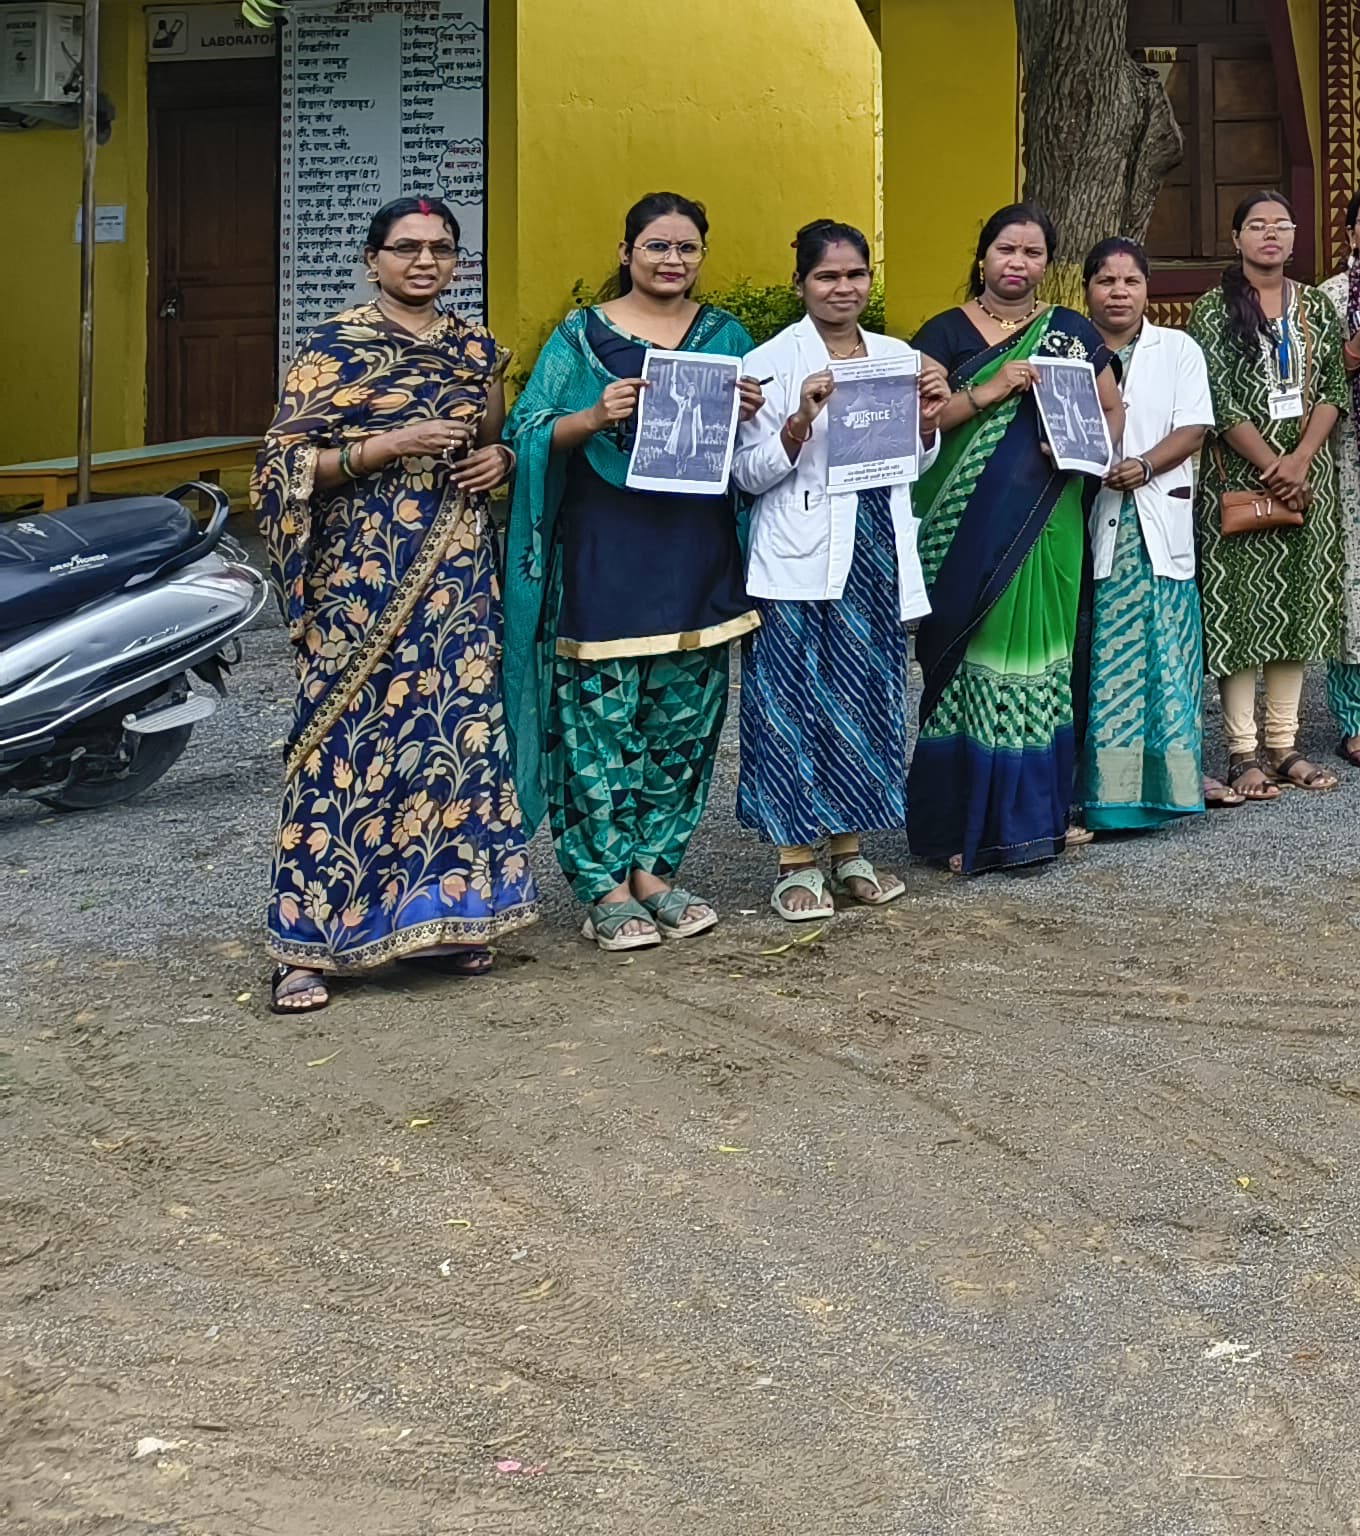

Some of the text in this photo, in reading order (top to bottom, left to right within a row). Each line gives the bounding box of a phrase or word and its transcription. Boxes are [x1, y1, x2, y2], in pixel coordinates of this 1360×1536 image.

[651, 362, 731, 396] JUSTICE
[1040, 367, 1093, 393] JUSTICE
[854, 408, 891, 423] JUSTICE
